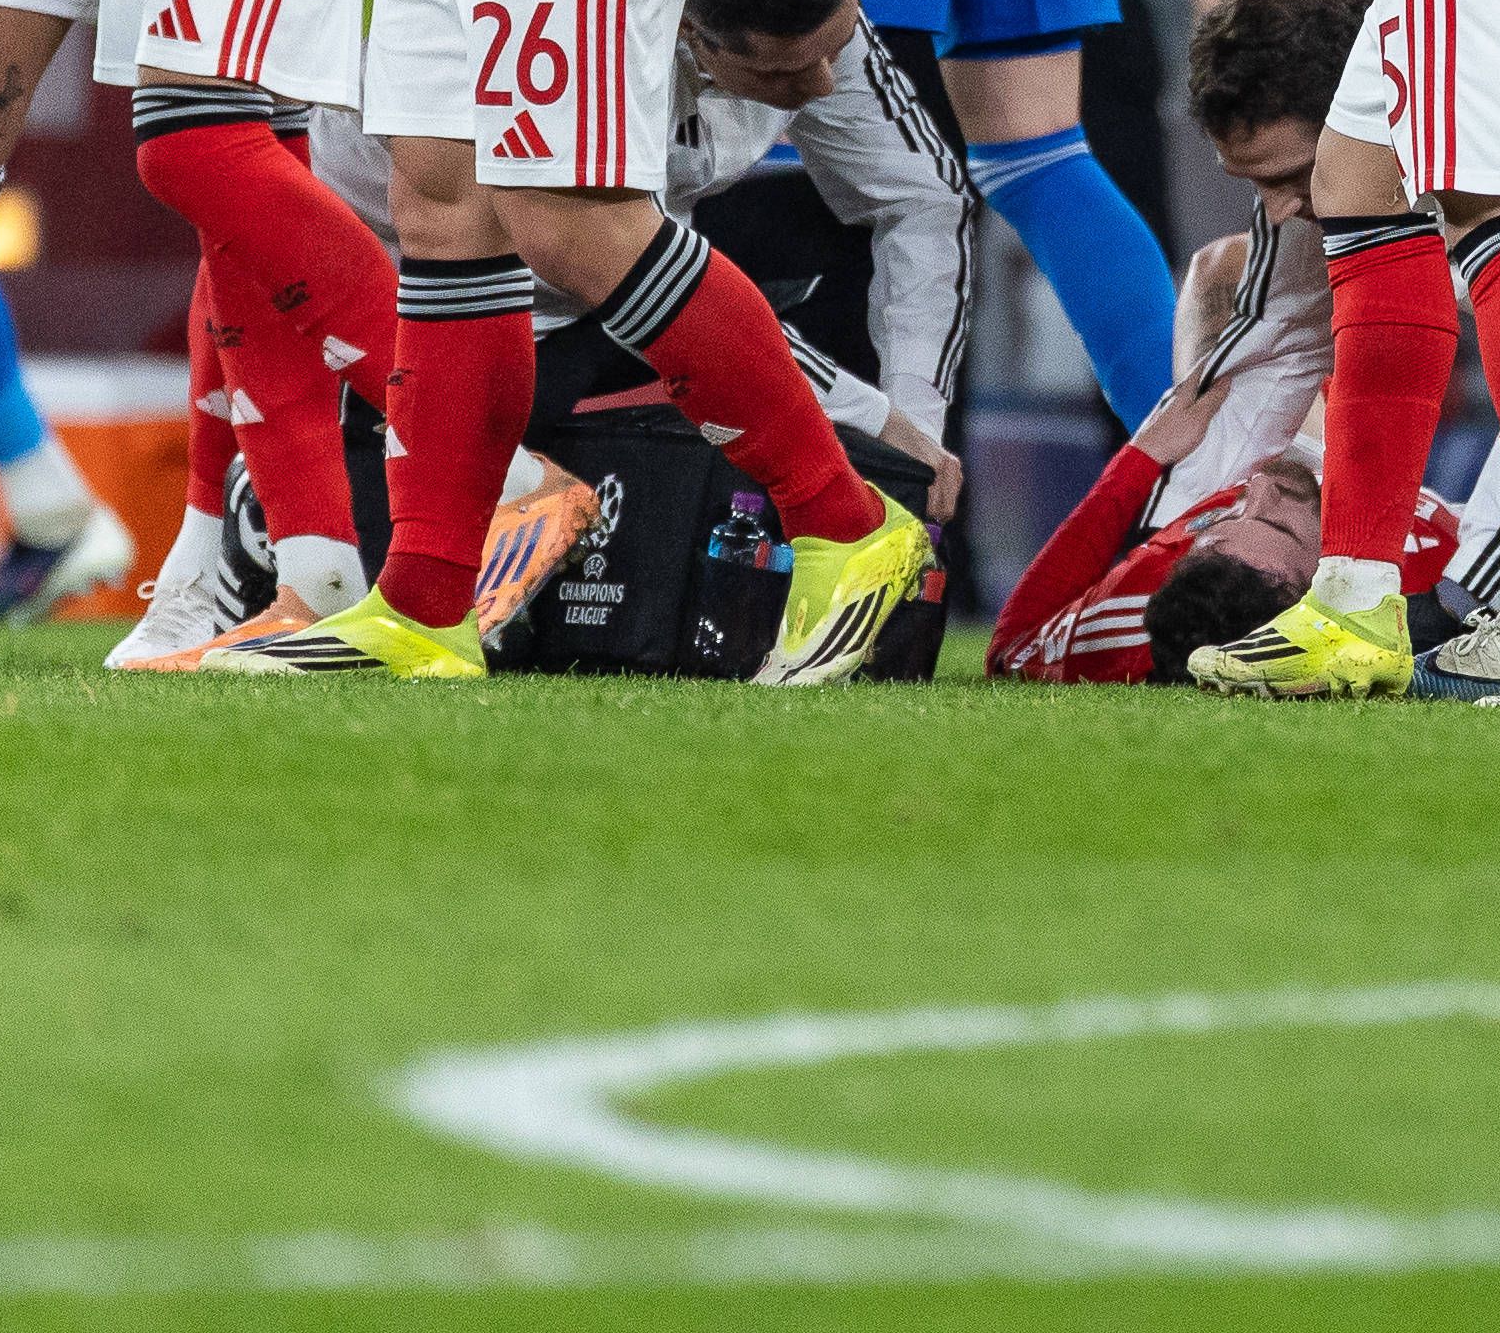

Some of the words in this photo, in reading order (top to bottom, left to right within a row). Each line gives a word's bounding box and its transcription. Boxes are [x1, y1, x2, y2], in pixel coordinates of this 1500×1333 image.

[472, 1, 569, 107] 26
[1378, 16, 1409, 128] 5
[559, 583, 625, 603] CHAMPIONS
[565, 607, 608, 625] LEAGUE
